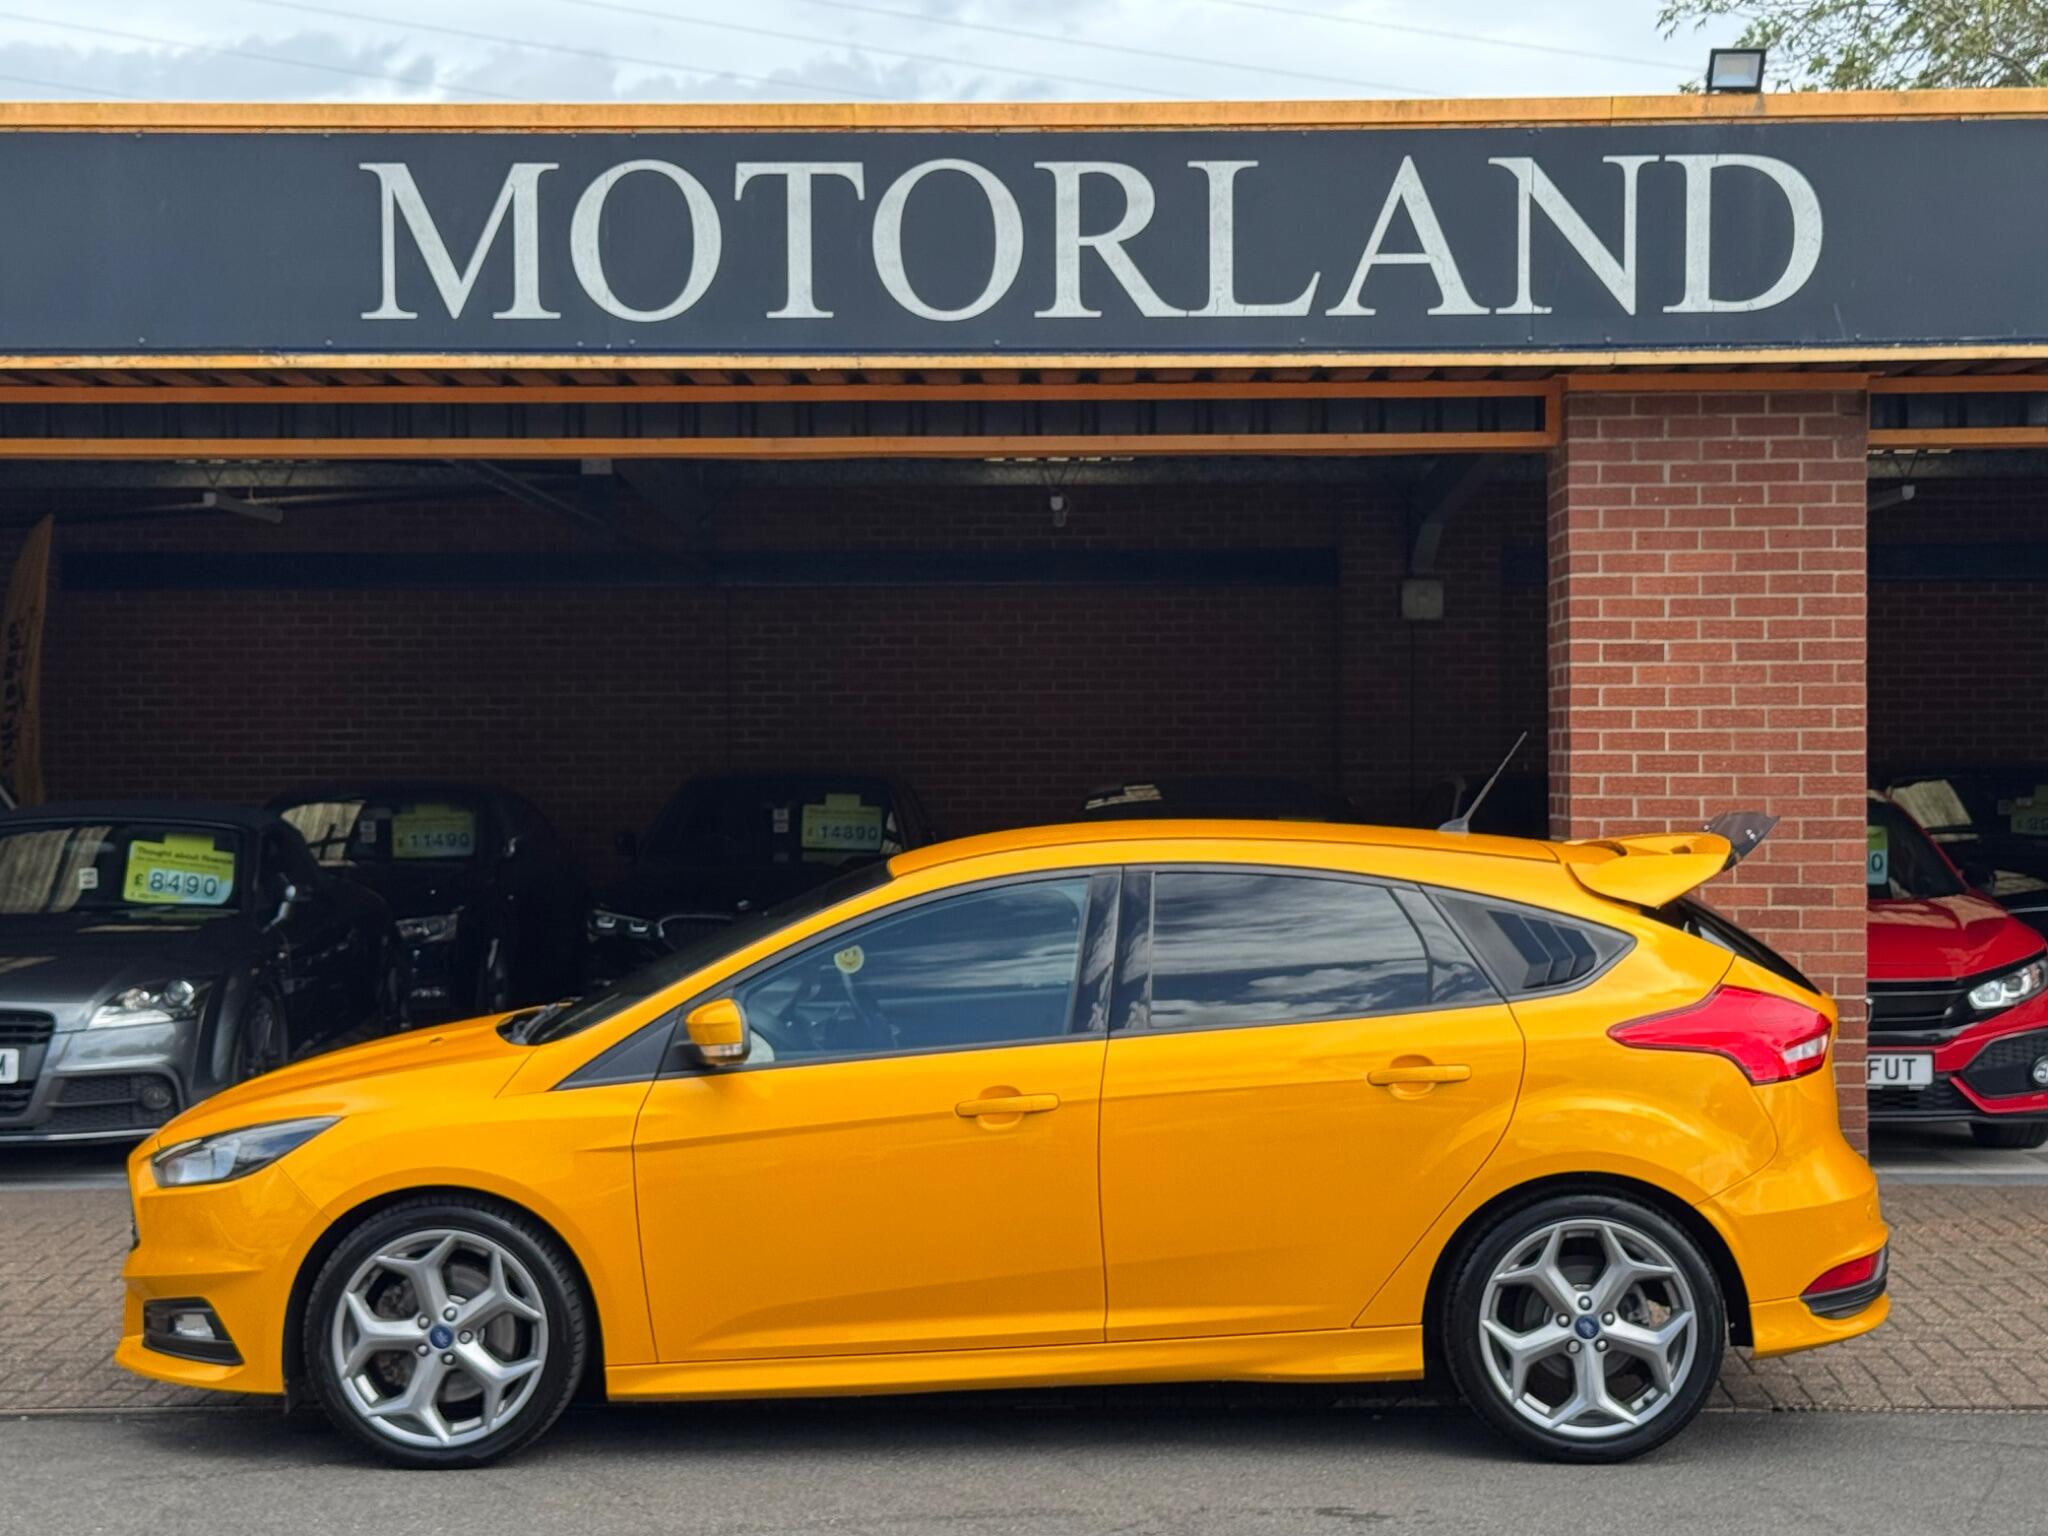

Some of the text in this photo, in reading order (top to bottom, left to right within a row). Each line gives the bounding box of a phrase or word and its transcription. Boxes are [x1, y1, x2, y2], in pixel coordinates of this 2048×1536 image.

[360, 155, 1822, 321] MOTORLAND
[150, 872, 217, 897] 8490
[1867, 1058, 1917, 1080] FUT
